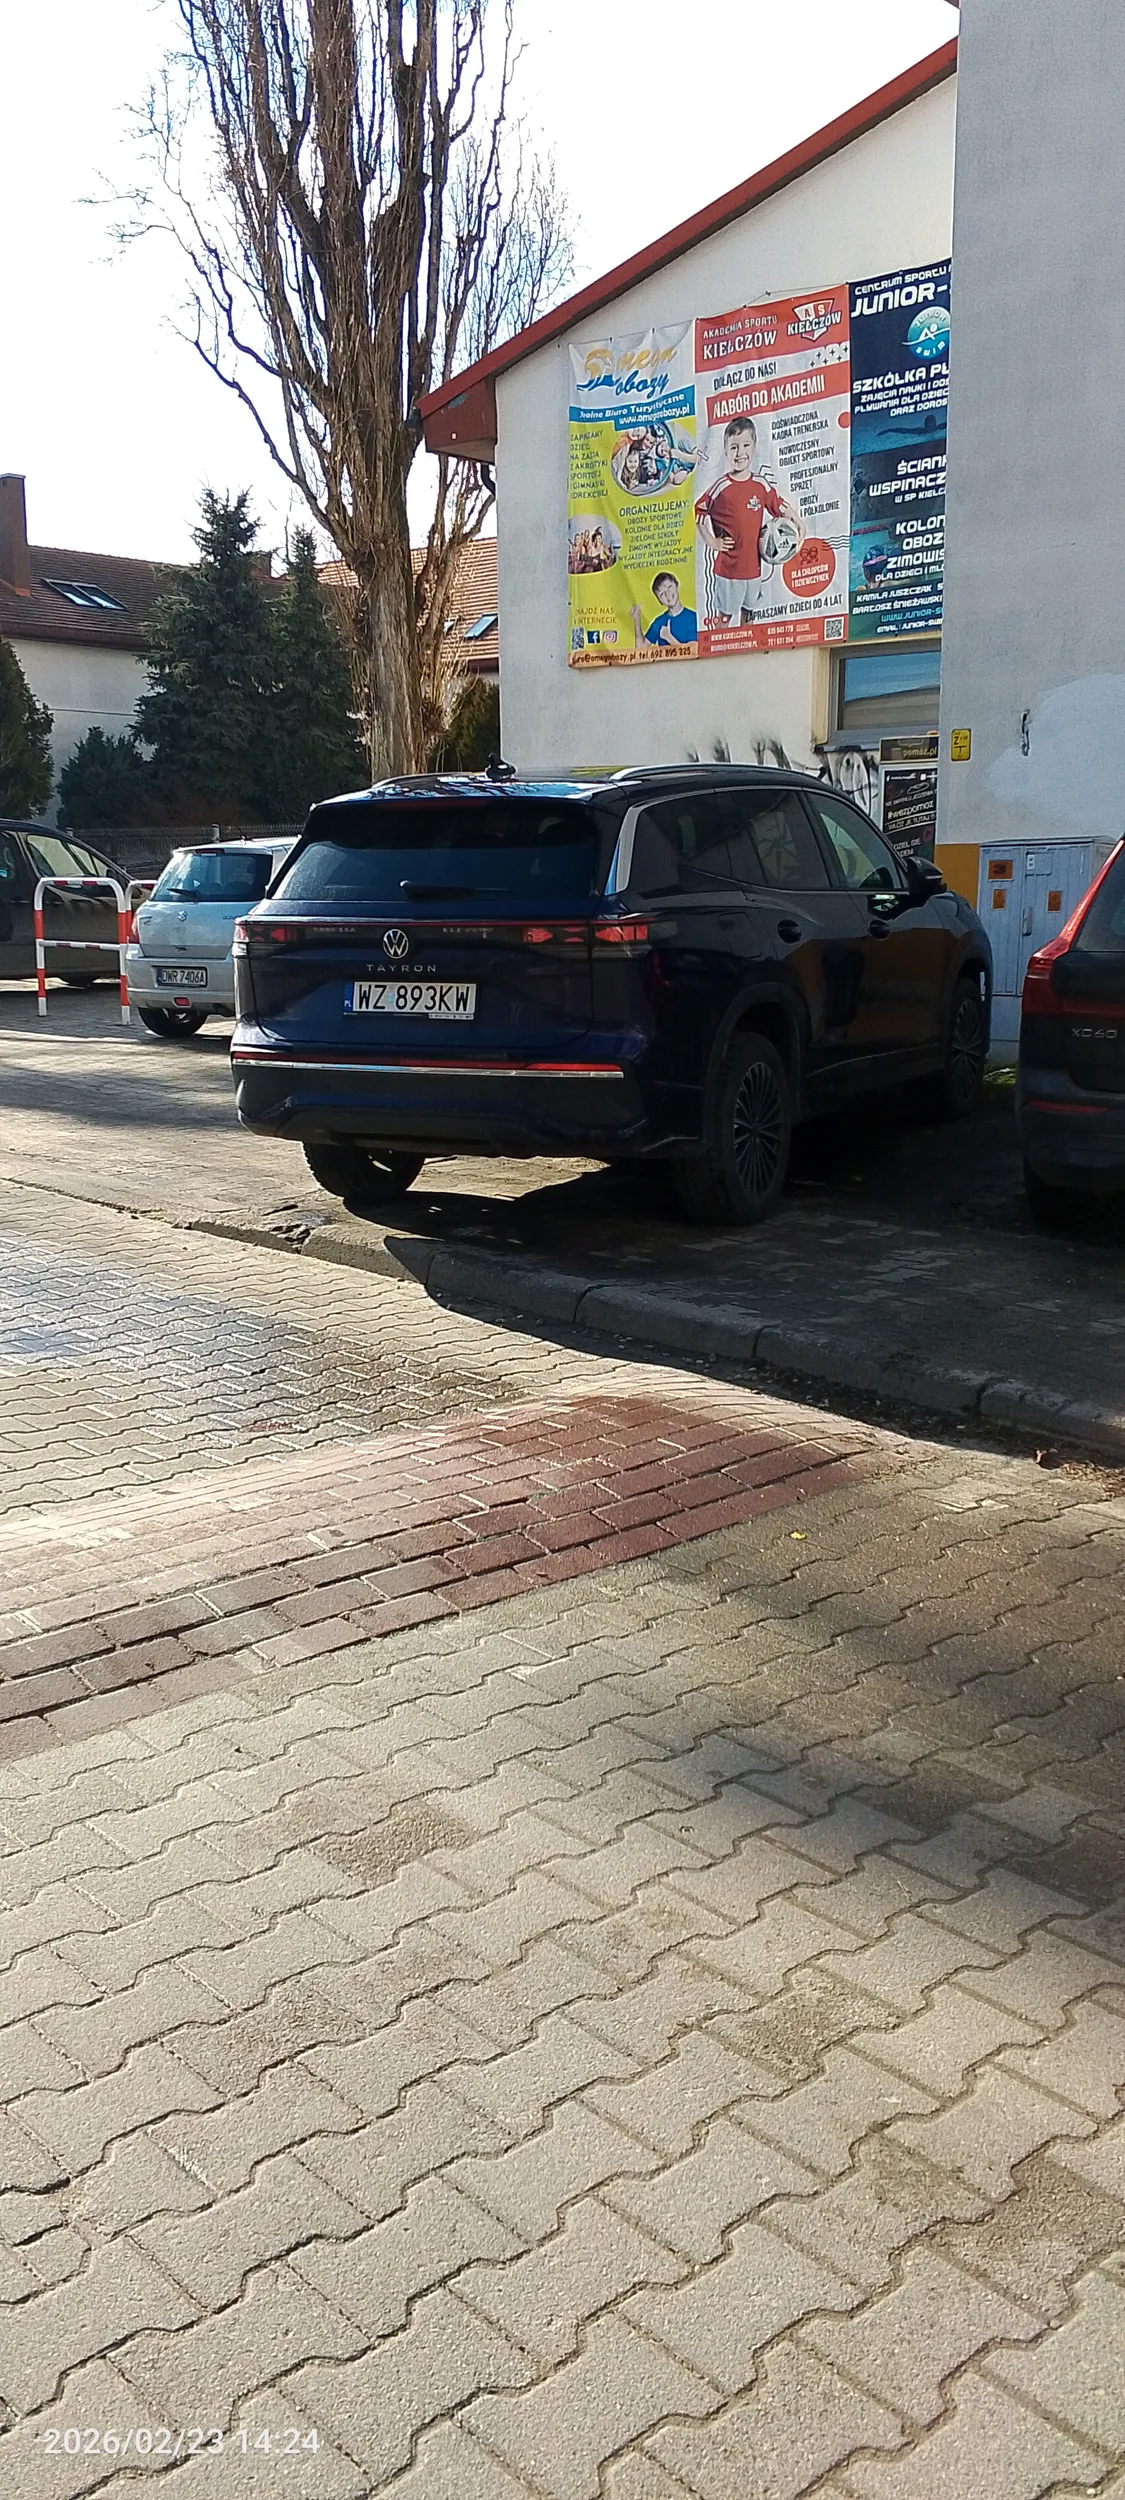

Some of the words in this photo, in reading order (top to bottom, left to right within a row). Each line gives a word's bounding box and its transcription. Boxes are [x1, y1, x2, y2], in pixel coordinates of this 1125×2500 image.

[854, 276, 902, 295] CENTRUM
[904, 266, 946, 283] SPORTU
[850, 282, 951, 318] JUNIOR-
[703, 322, 742, 340] AKADEMIA
[744, 314, 778, 328] SPORTU
[787, 311, 842, 336] KIEŁCZÓW
[703, 330, 778, 360] KIEŁCZÓW
[713, 371, 742, 391] DOŁĄCZ
[744, 366, 755, 380] DO
[853, 367, 926, 394] SZKÓŁKA
[713, 394, 752, 420] NABÓR
[751, 391, 768, 408] DO
[770, 374, 825, 405] AKADEMII
[861, 389, 898, 403] ZAJĘCIA
[899, 383, 926, 396] NAUKI
[901, 392, 920, 405] DLA
[605, 408, 628, 418] Biuro
[890, 405, 915, 417] ORAZ
[772, 410, 819, 430] DOŚWIADCZONA
[793, 419, 829, 437] TRENERSKA
[778, 439, 820, 456] NOWOCZESNY
[801, 446, 835, 462] SPORTOWY
[790, 462, 838, 482] PROFESJONALNY
[790, 479, 813, 492] SPRZĘT
[869, 472, 947, 497] WSPINACZ
[800, 494, 819, 506] OBOZY
[894, 495, 903, 503] W
[904, 493, 916, 502] SP
[650, 512, 682, 522] SPORTOWE
[625, 525, 652, 534] KOLONIE
[653, 522, 665, 531] DLA
[630, 533, 655, 543] ZIELONE
[654, 539, 682, 548] WYJAZDY
[902, 532, 945, 551] OBOZ
[618, 552, 646, 561] WYJAZDY
[648, 546, 693, 558] INTEGRACYJNE
[624, 561, 655, 570] WYCIECZKI
[656, 556, 687, 566] RODZINNE
[875, 573, 893, 582] DLA
[894, 567, 923, 579] DZIECI
[856, 591, 888, 602] KAMILA
[888, 584, 932, 598] JUSZCZAK
[600, 607, 614, 615] NAS
[745, 605, 787, 622] ZAPRASZAMY
[789, 600, 812, 614] DZIECI
[813, 598, 822, 610] OD
[824, 598, 829, 607] 4
[829, 594, 842, 606] LAT
[852, 602, 892, 615] BARTOSZ
[881, 607, 944, 622] WWW.JUNIOR-S
[638, 651, 648, 660] tel
[650, 648, 662, 659] 692
[679, 646, 691, 656] 225
[366, 964, 436, 972] TAYRON
[163, 970, 178, 982] DWR
[180, 971, 204, 983] 7406A
[358, 984, 387, 1010] WZ
[395, 984, 470, 1012] 893KW
[1072, 1028, 1117, 1039] XC60
